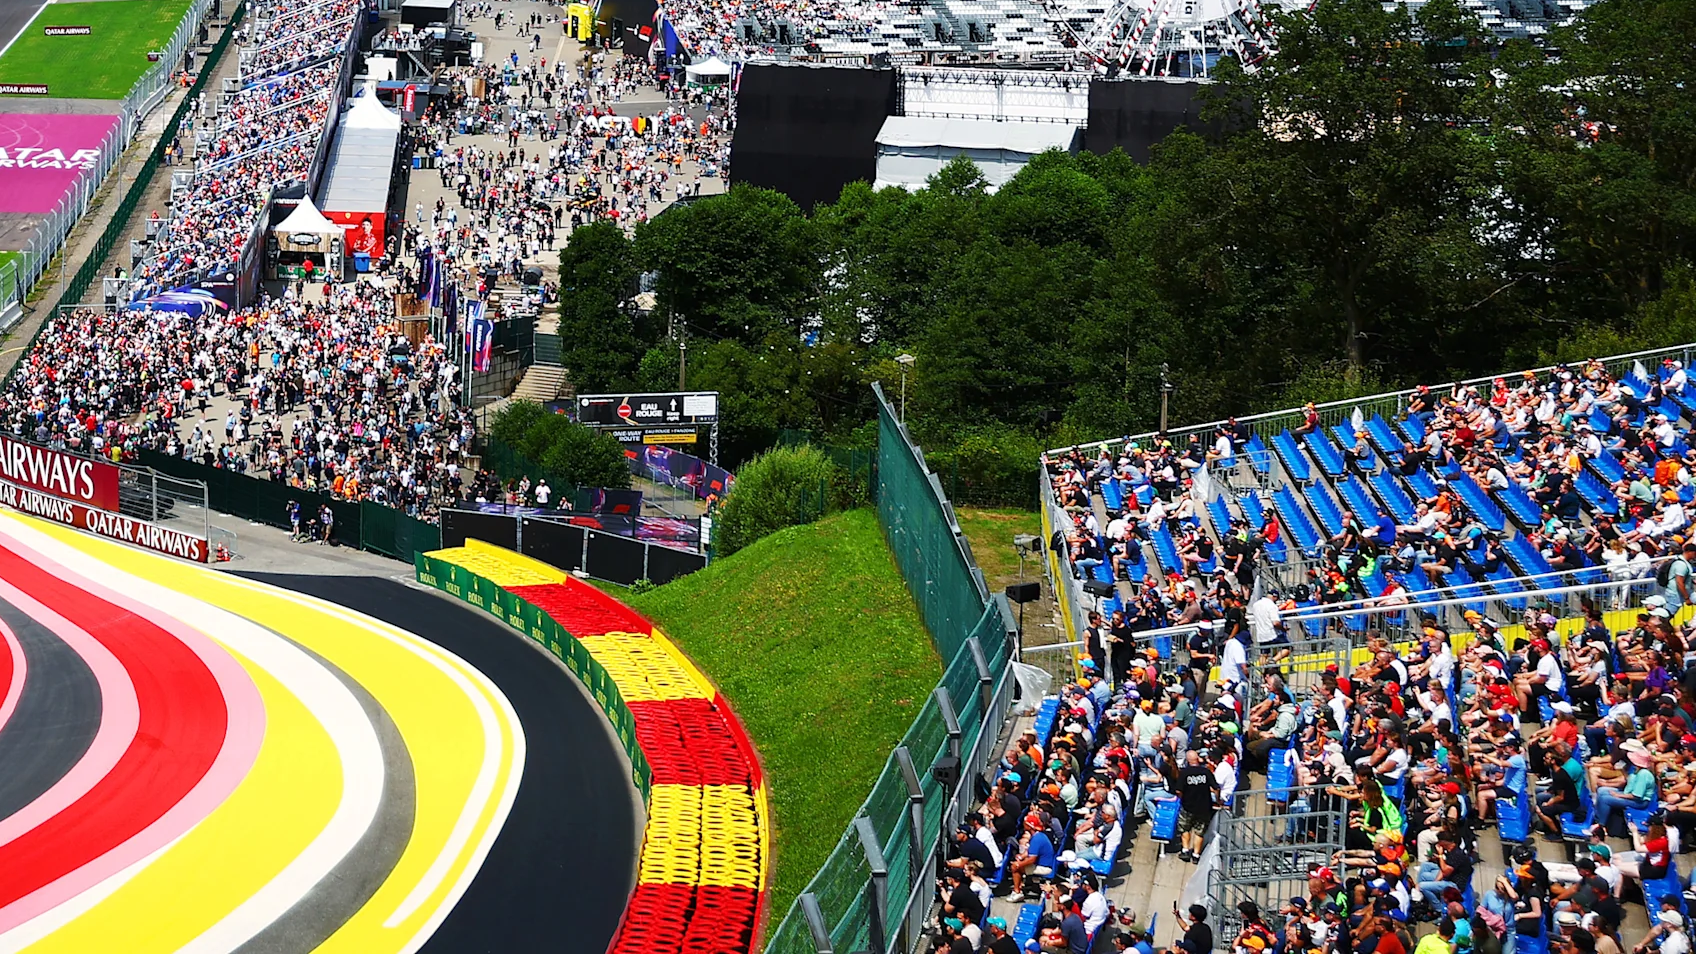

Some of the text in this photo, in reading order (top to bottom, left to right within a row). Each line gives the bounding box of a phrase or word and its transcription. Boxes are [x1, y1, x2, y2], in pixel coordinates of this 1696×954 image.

[19, 86, 47, 94] AIRWAYS
[636, 410, 663, 418] ROUGE
[19, 490, 74, 525] AIRWAYS
[86, 509, 200, 560] QATAR AIRWAYS
[420, 572, 437, 586] ROLEX
[446, 581, 460, 596] ROLEX
[468, 592, 484, 607] ROLEX
[491, 602, 504, 618] ROLEX
[509, 614, 525, 631] ROLEX
[532, 626, 545, 644] ROLEX
